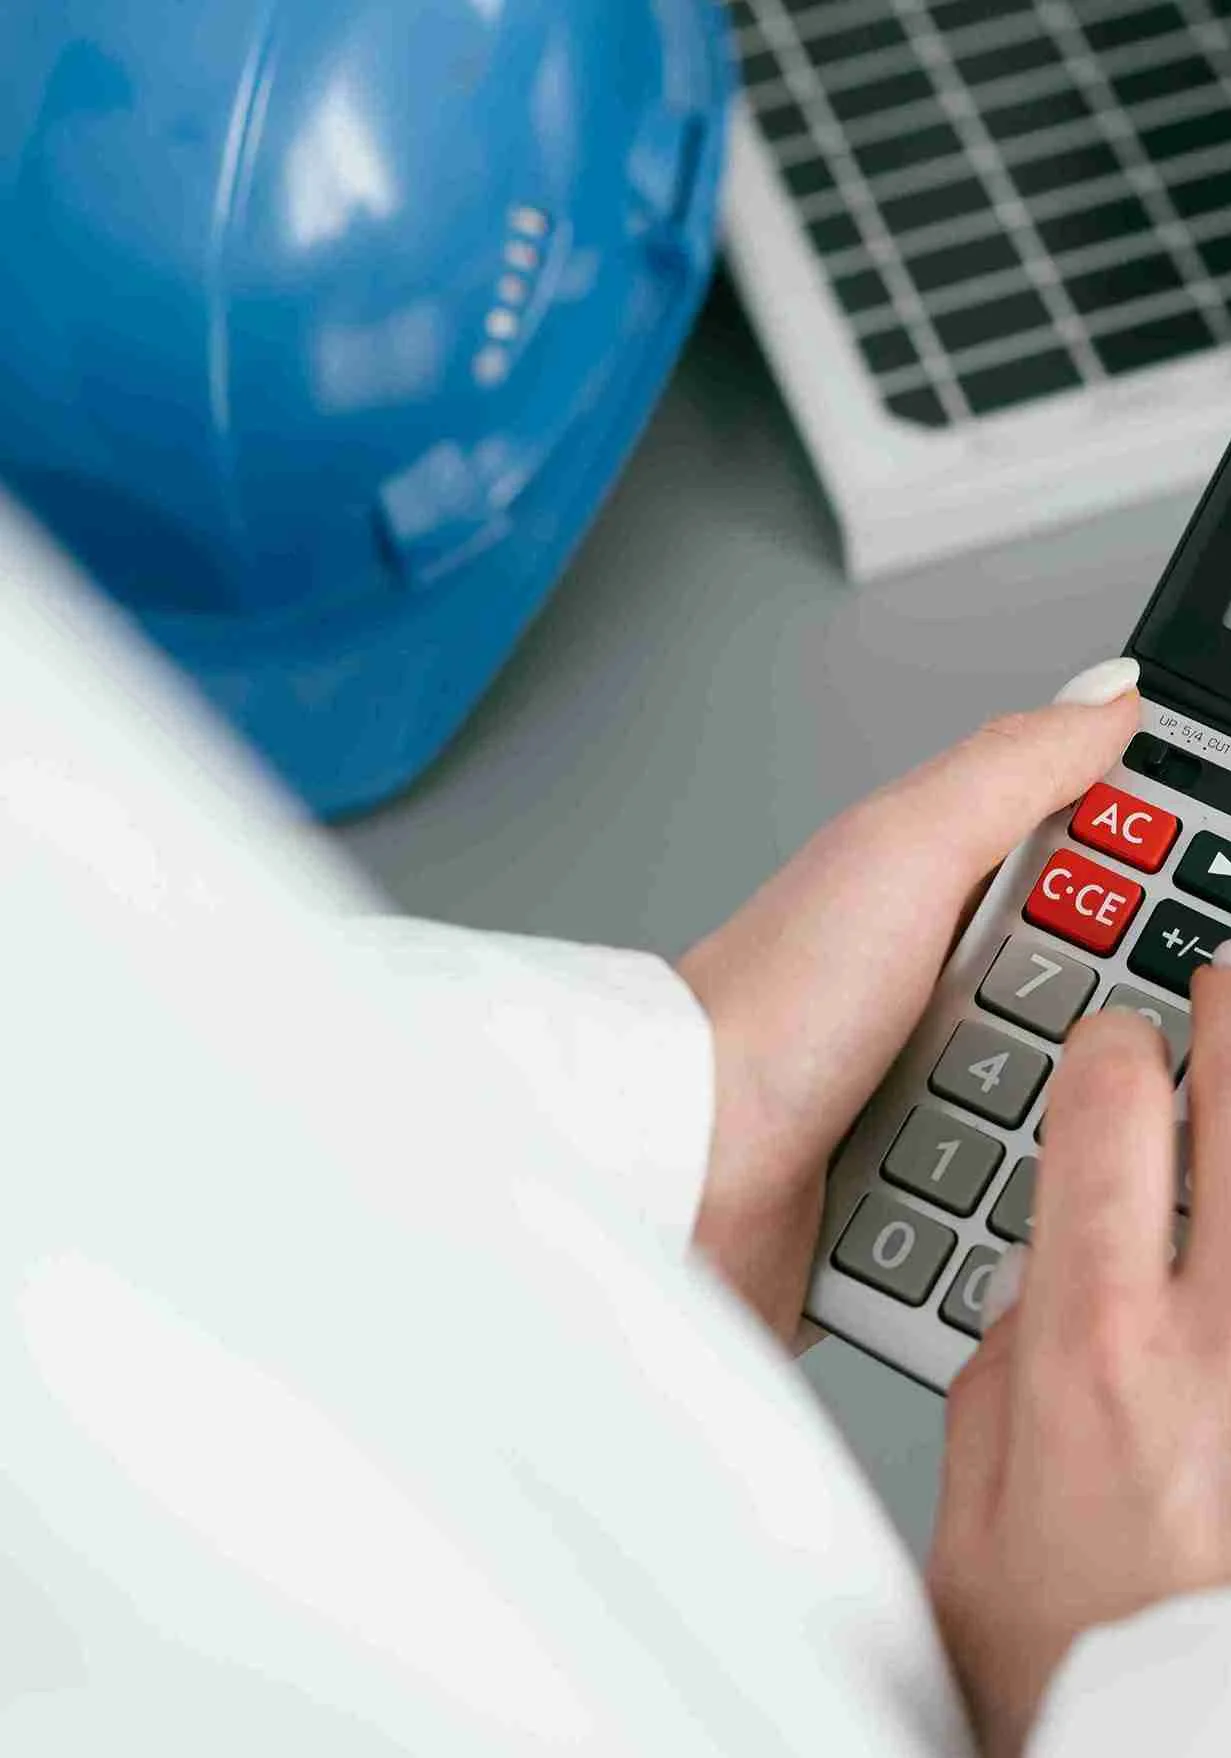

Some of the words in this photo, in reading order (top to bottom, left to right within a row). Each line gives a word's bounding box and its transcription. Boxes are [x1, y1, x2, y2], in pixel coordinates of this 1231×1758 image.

[1160, 715, 1178, 728] UP
[1182, 726, 1203, 741] 5/4
[1208, 737, 1231, 753] CUT
[1091, 802, 1153, 844] AC
[1015, 953, 1063, 999] 7
[968, 1052, 1011, 1094] 4
[931, 1139, 962, 1182] 1
[872, 1221, 916, 1269] 0
